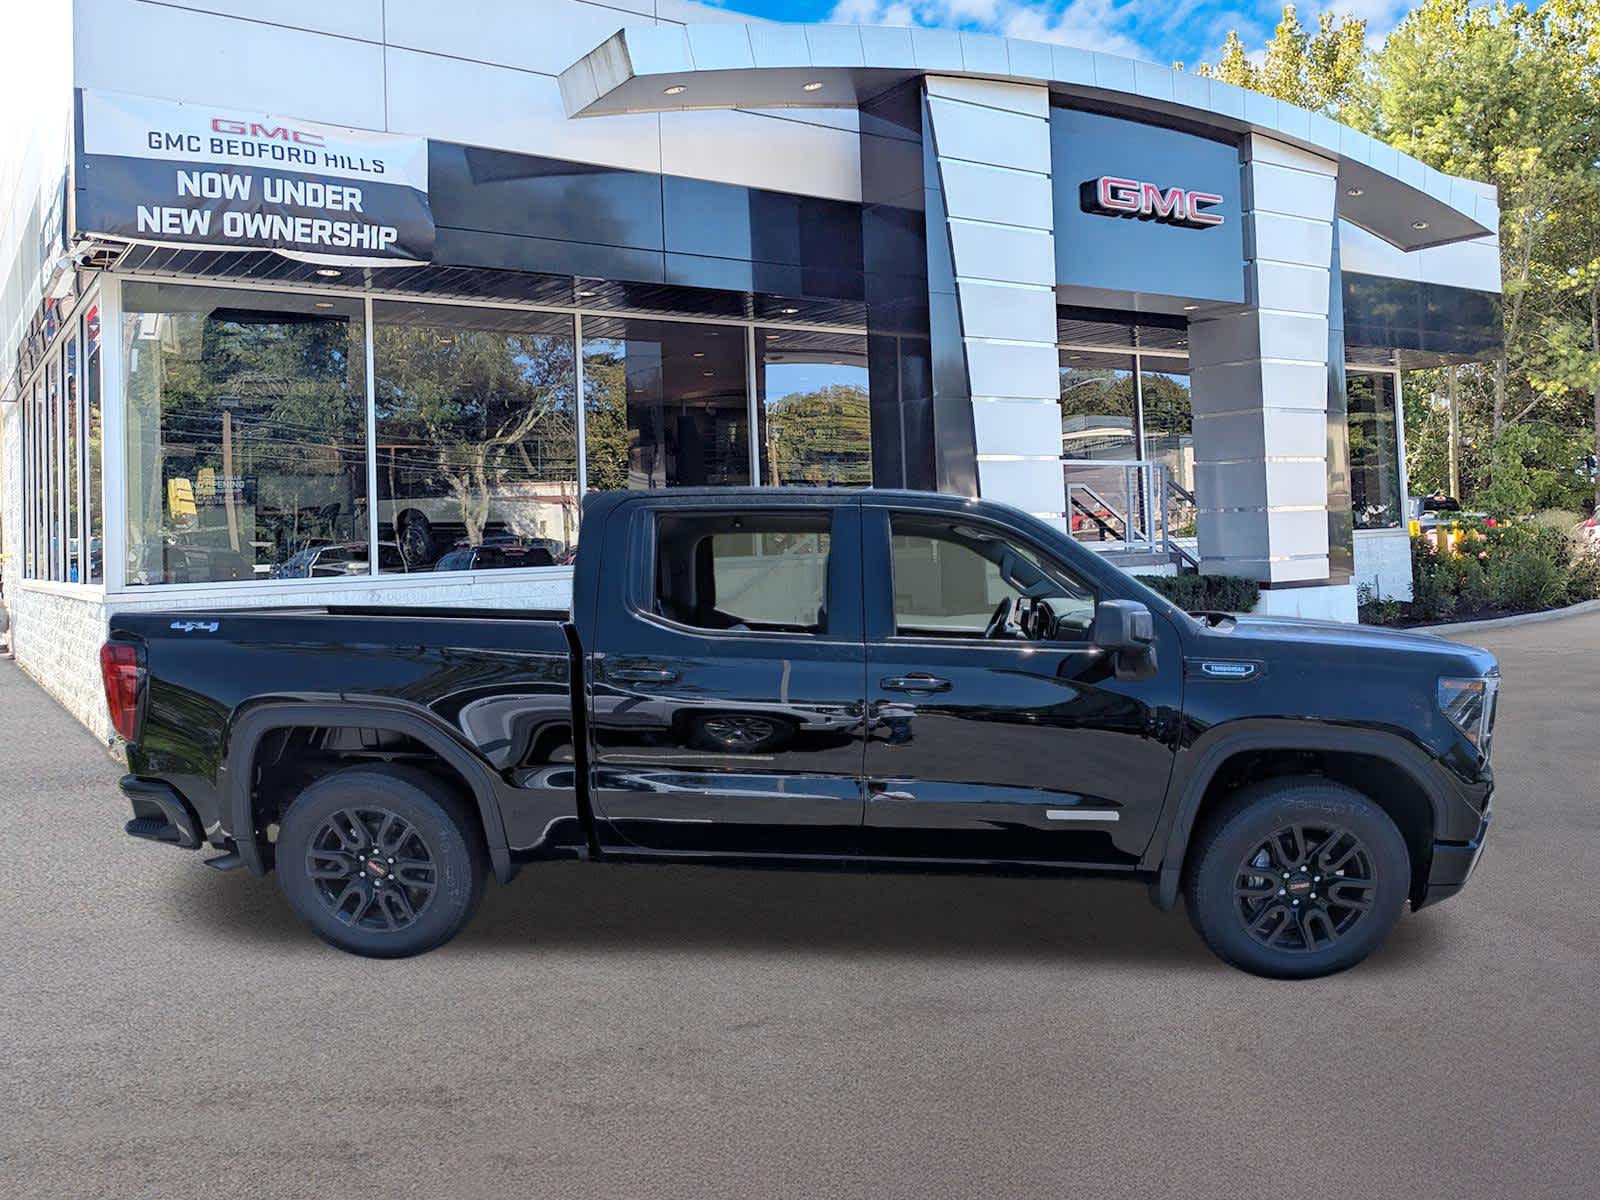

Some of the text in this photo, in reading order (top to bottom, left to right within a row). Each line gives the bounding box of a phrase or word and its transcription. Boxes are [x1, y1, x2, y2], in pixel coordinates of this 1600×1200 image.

[148, 131, 385, 174] GMC BEDFORD HILLS
[211, 118, 325, 148] GMC
[177, 170, 364, 212] NOW UNDER
[1097, 175, 1225, 225] GMC
[137, 205, 398, 250] NEW OWNERSHIP
